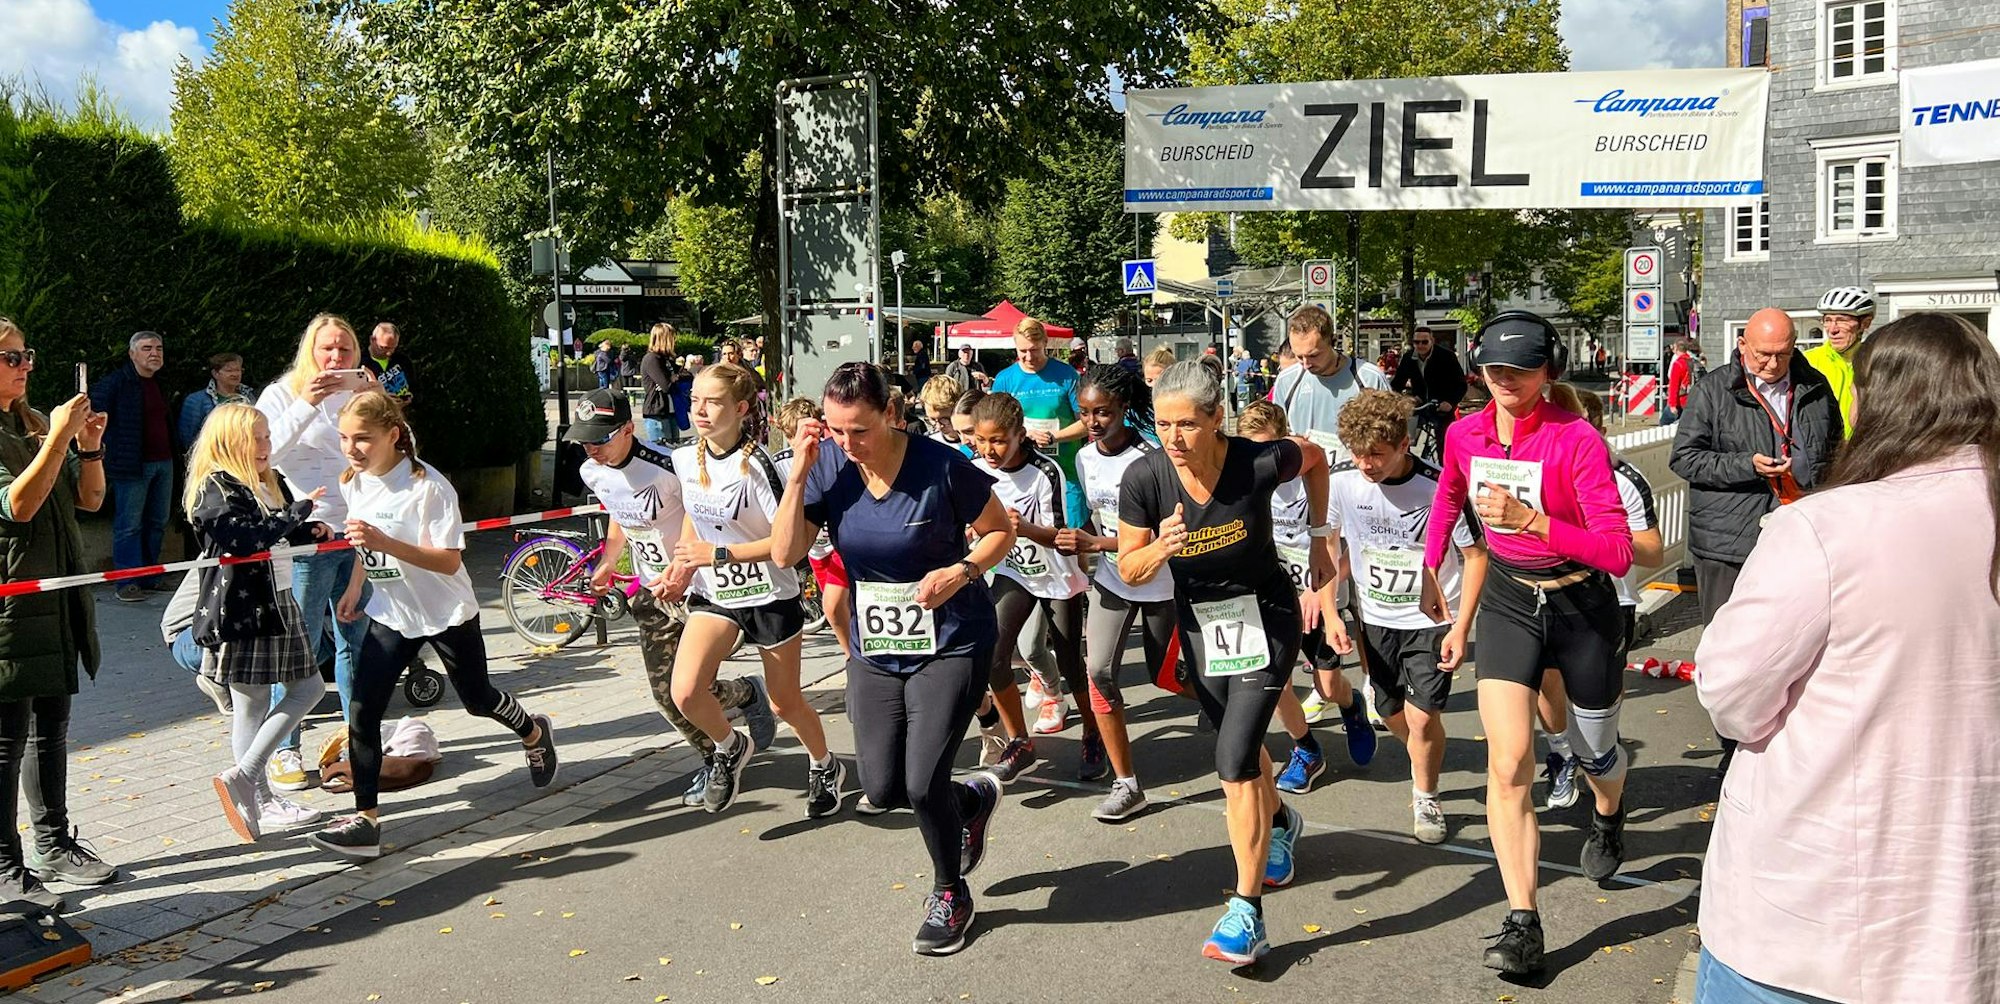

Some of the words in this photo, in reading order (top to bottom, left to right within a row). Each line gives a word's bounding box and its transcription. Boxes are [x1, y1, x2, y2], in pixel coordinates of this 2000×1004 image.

[1574, 89, 1720, 117] Campana
[1146, 104, 1266, 129] Campana
[1300, 99, 1530, 188] ZIEL
[1595, 134, 1708, 151] BURSCHEID
[1161, 144, 1254, 161] BURSCHEID
[1638, 260, 1649, 270] 20
[1315, 271, 1324, 280] 20
[1474, 459, 1518, 471] Burscheider
[617, 511, 644, 521] SCHULE
[694, 503, 725, 518] SCHULE
[1370, 525, 1408, 539] SCHULE
[629, 538, 663, 563] 83
[714, 561, 763, 587] 584
[1370, 564, 1417, 593] 577
[865, 604, 926, 636] 632
[1207, 608, 1245, 621] Stadtlauf
[1215, 621, 1244, 655] 47
